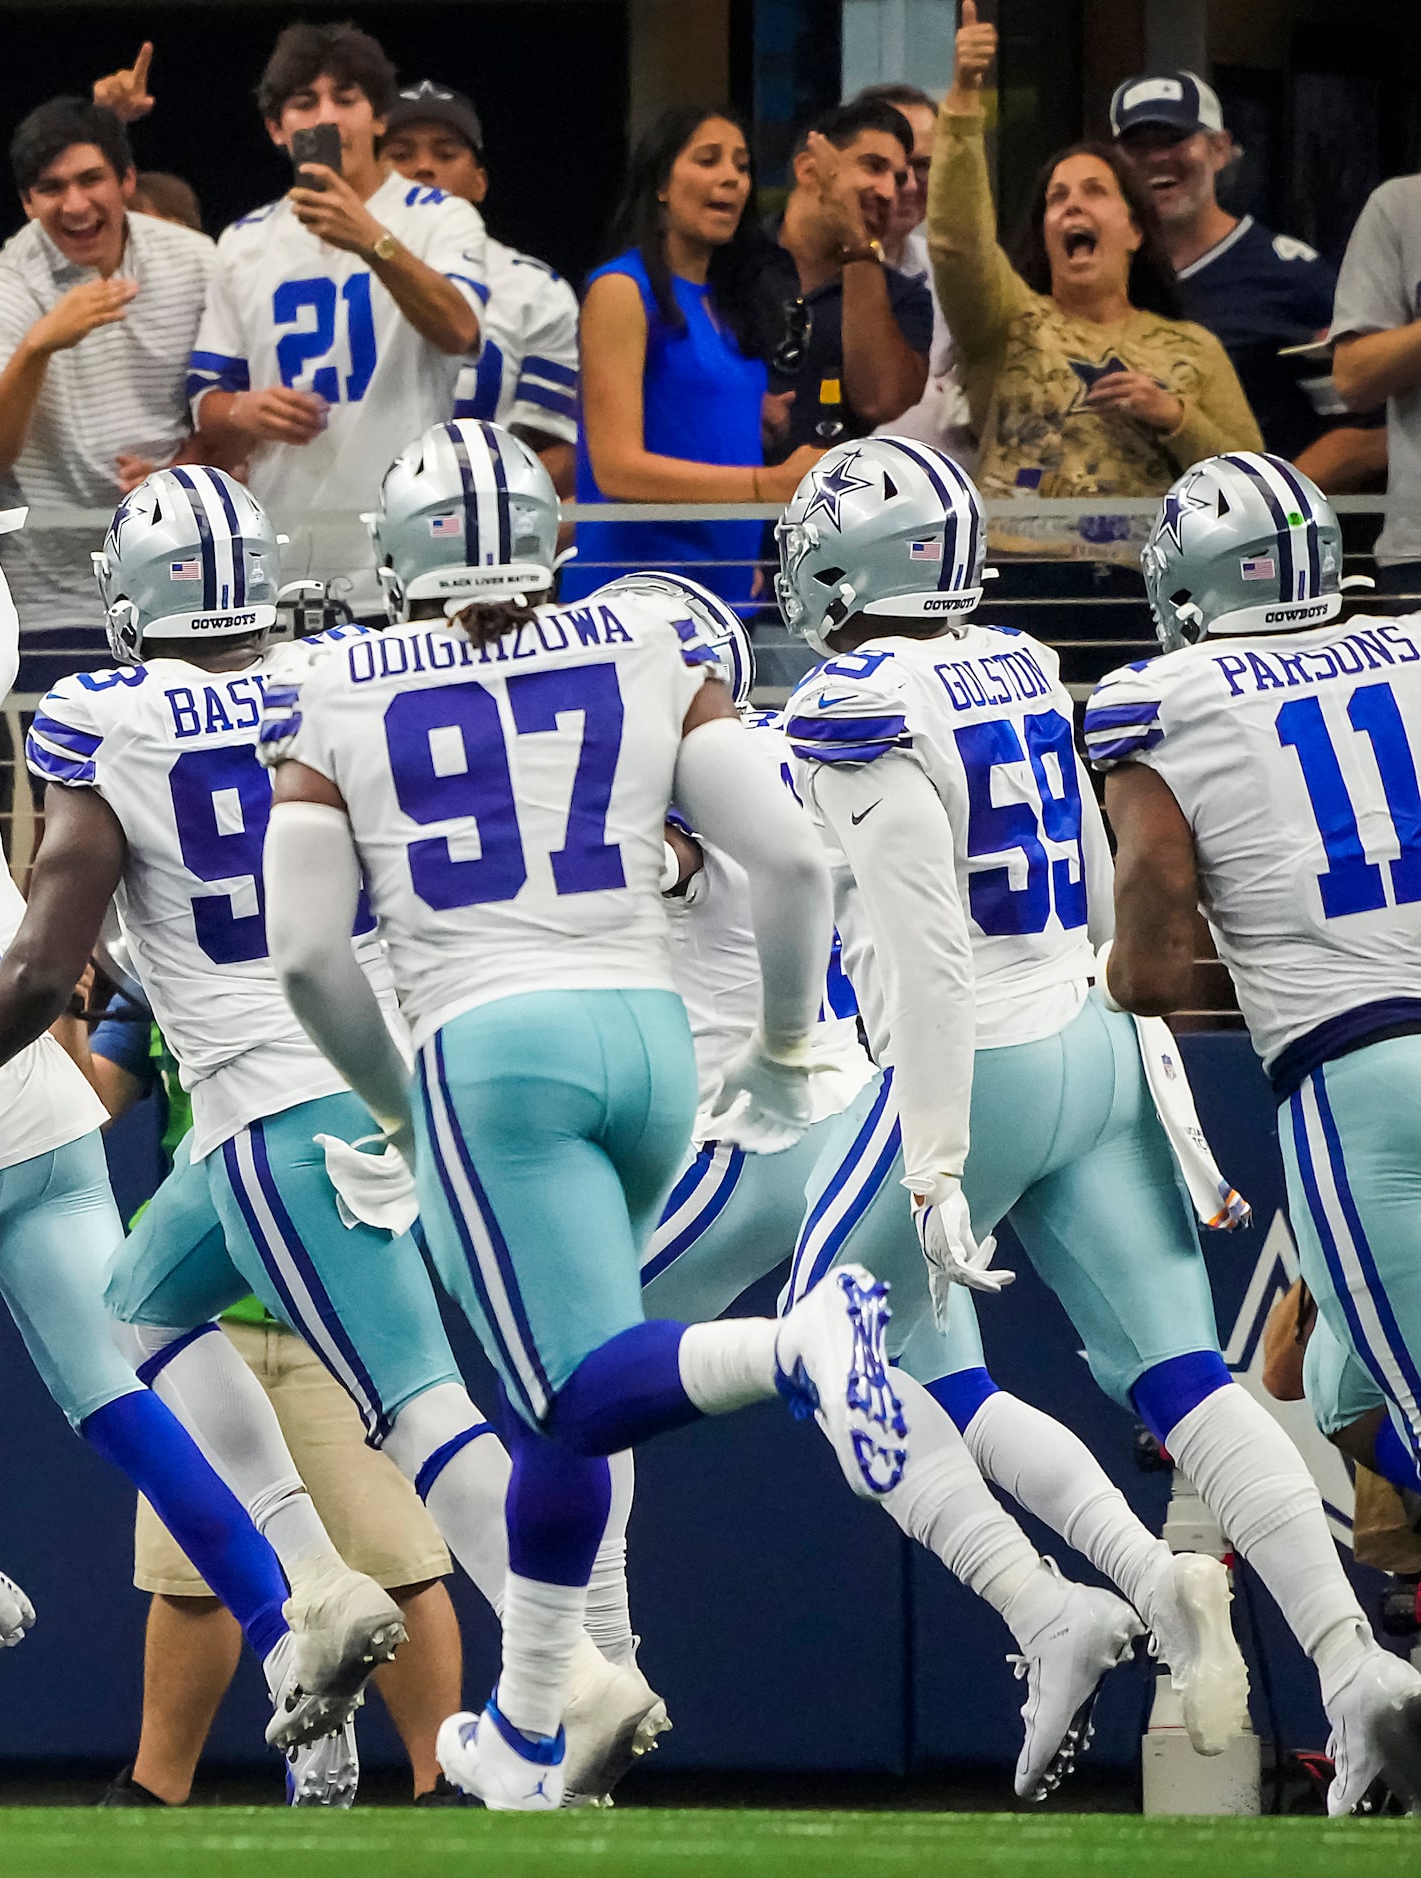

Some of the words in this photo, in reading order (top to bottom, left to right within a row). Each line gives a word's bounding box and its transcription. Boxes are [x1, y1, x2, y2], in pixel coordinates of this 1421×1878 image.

[273, 272, 377, 404] 21
[191, 612, 257, 631] COWBOYS
[923, 596, 976, 611] COWBOYS
[1264, 603, 1329, 623] COWBOYS
[934, 648, 1053, 712] GOLSTON
[1212, 626, 1421, 697] PARSONS
[384, 662, 627, 911] 97
[952, 708, 1088, 936] 59
[1275, 682, 1421, 920] 11
